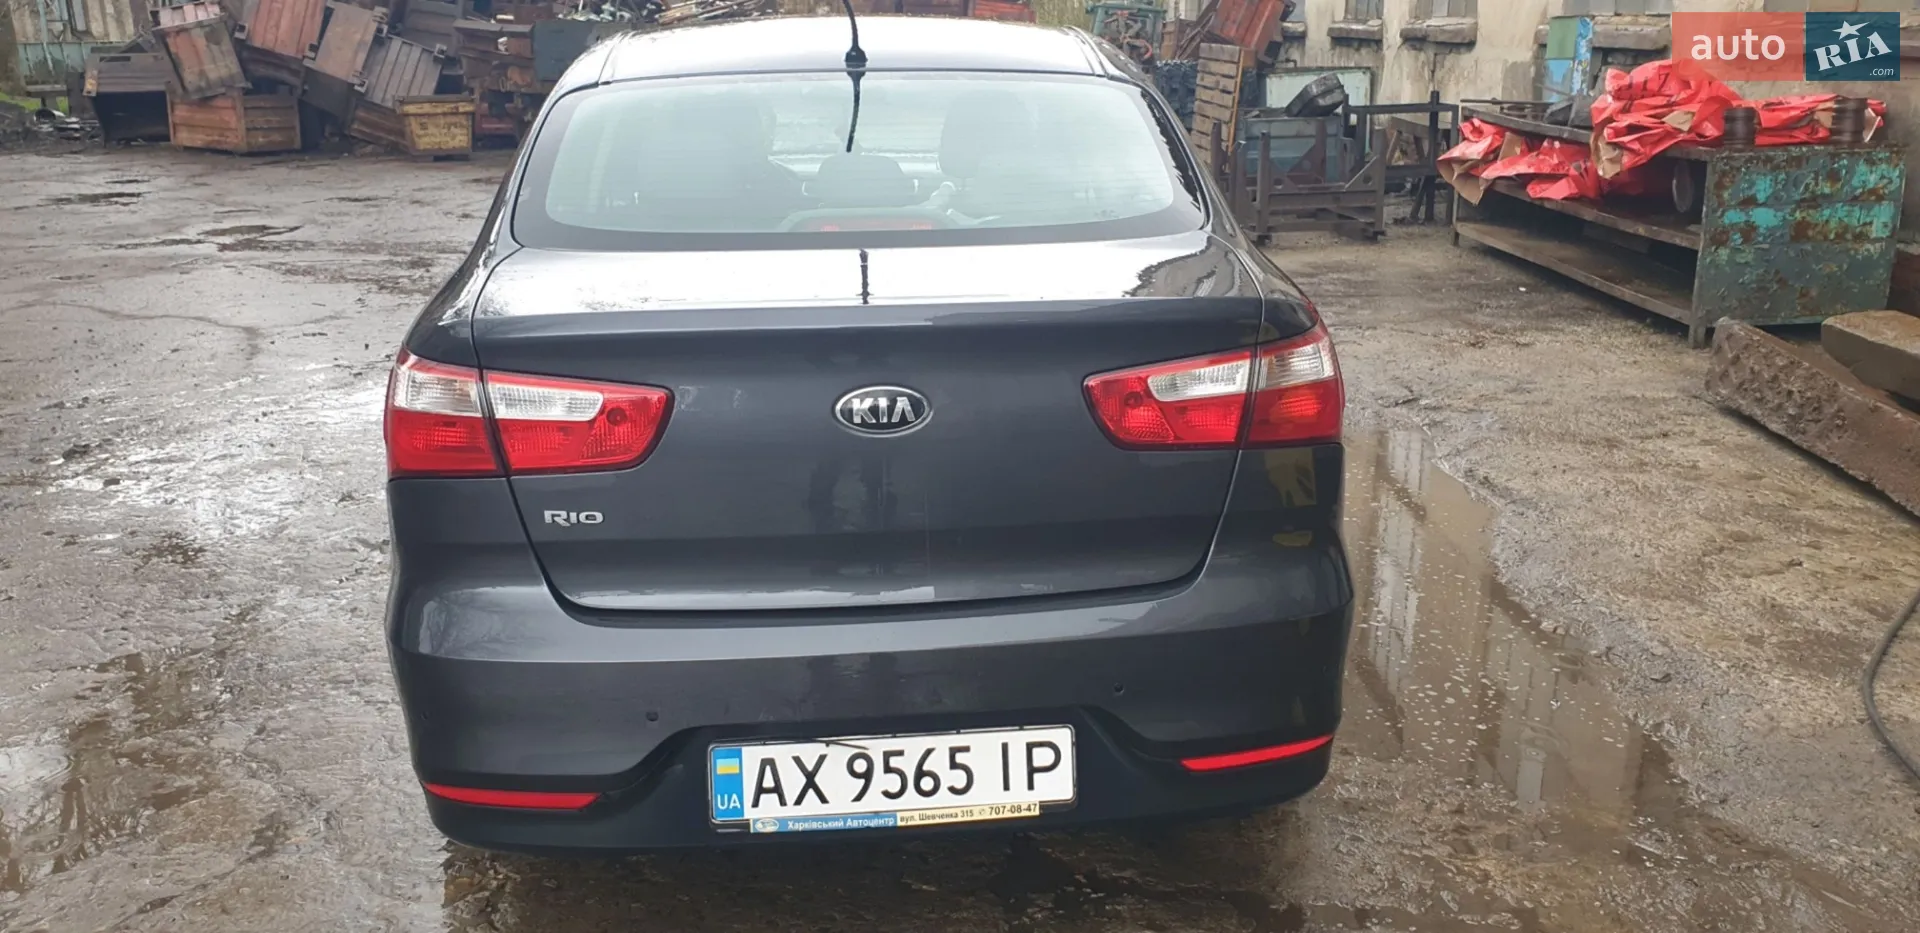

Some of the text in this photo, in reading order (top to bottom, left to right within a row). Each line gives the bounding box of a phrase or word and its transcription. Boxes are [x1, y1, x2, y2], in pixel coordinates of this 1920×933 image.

[851, 398, 916, 424] KIA
[544, 511, 604, 526] RIO
[751, 741, 1062, 808] AX 9565 IP
[717, 794, 741, 810] UA
[787, 818, 844, 831] Харківський
[846, 815, 895, 828] Автоцентр
[899, 814, 917, 824] вул.
[960, 808, 974, 818] 315
[988, 804, 1037, 816] 707-08-47
